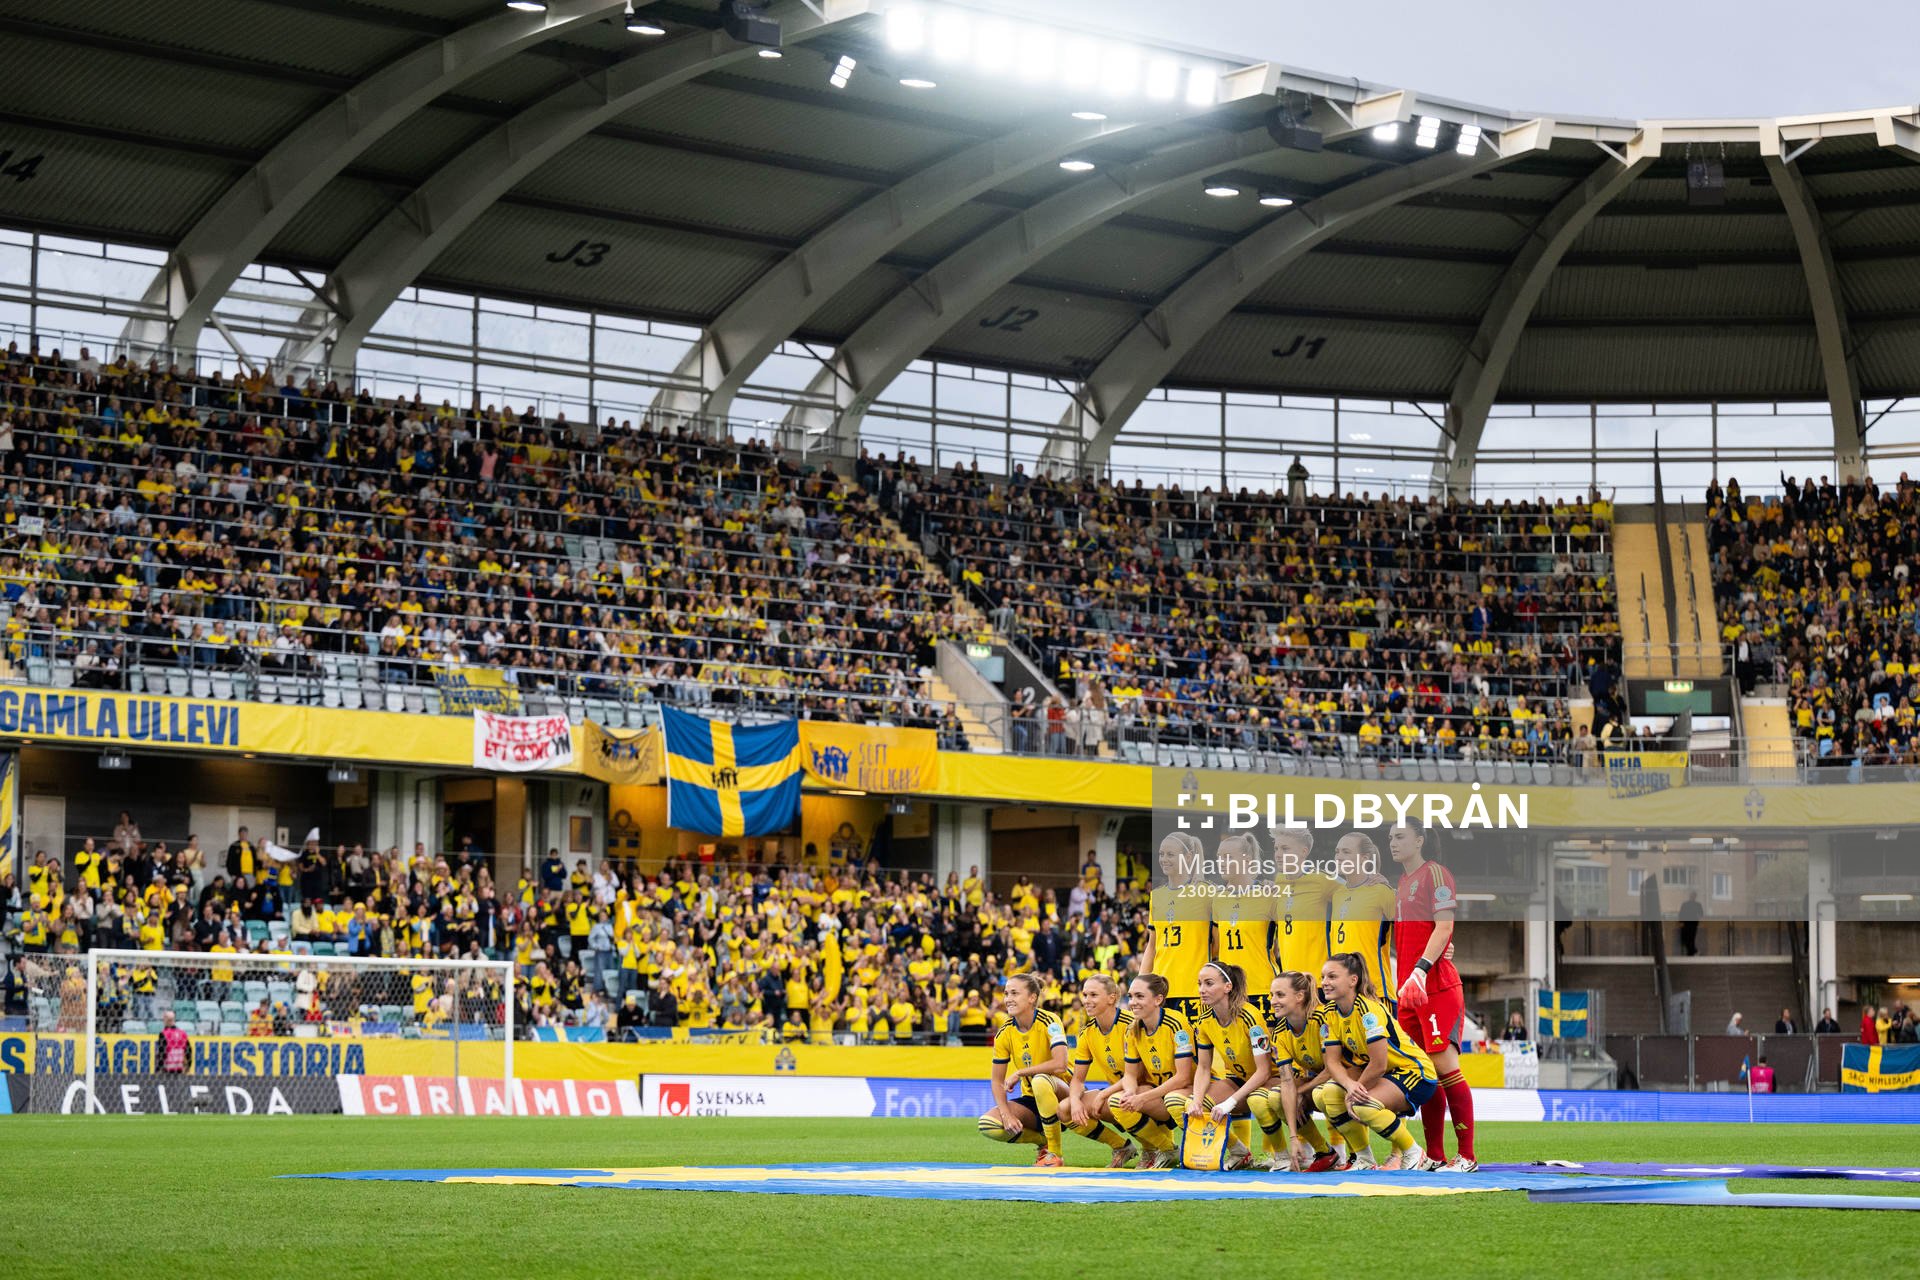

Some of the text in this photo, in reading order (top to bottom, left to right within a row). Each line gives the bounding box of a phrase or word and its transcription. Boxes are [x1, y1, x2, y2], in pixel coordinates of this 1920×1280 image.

[546, 239, 611, 268] J3
[979, 305, 1040, 332] J2
[1271, 334, 1328, 359] J1
[0, 690, 239, 746] GAMLA ULLEVI
[1608, 756, 1643, 772] HEJA
[1163, 925, 1182, 947] 13
[1284, 914, 1293, 935] 8
[1336, 922, 1346, 944] 6
[1226, 929, 1244, 950] 11
[1428, 1013, 1441, 1036] 1
[194, 1041, 366, 1077] HISTORIA
[371, 1083, 612, 1117] CRAMO
[696, 1091, 765, 1105] SVENSKA
